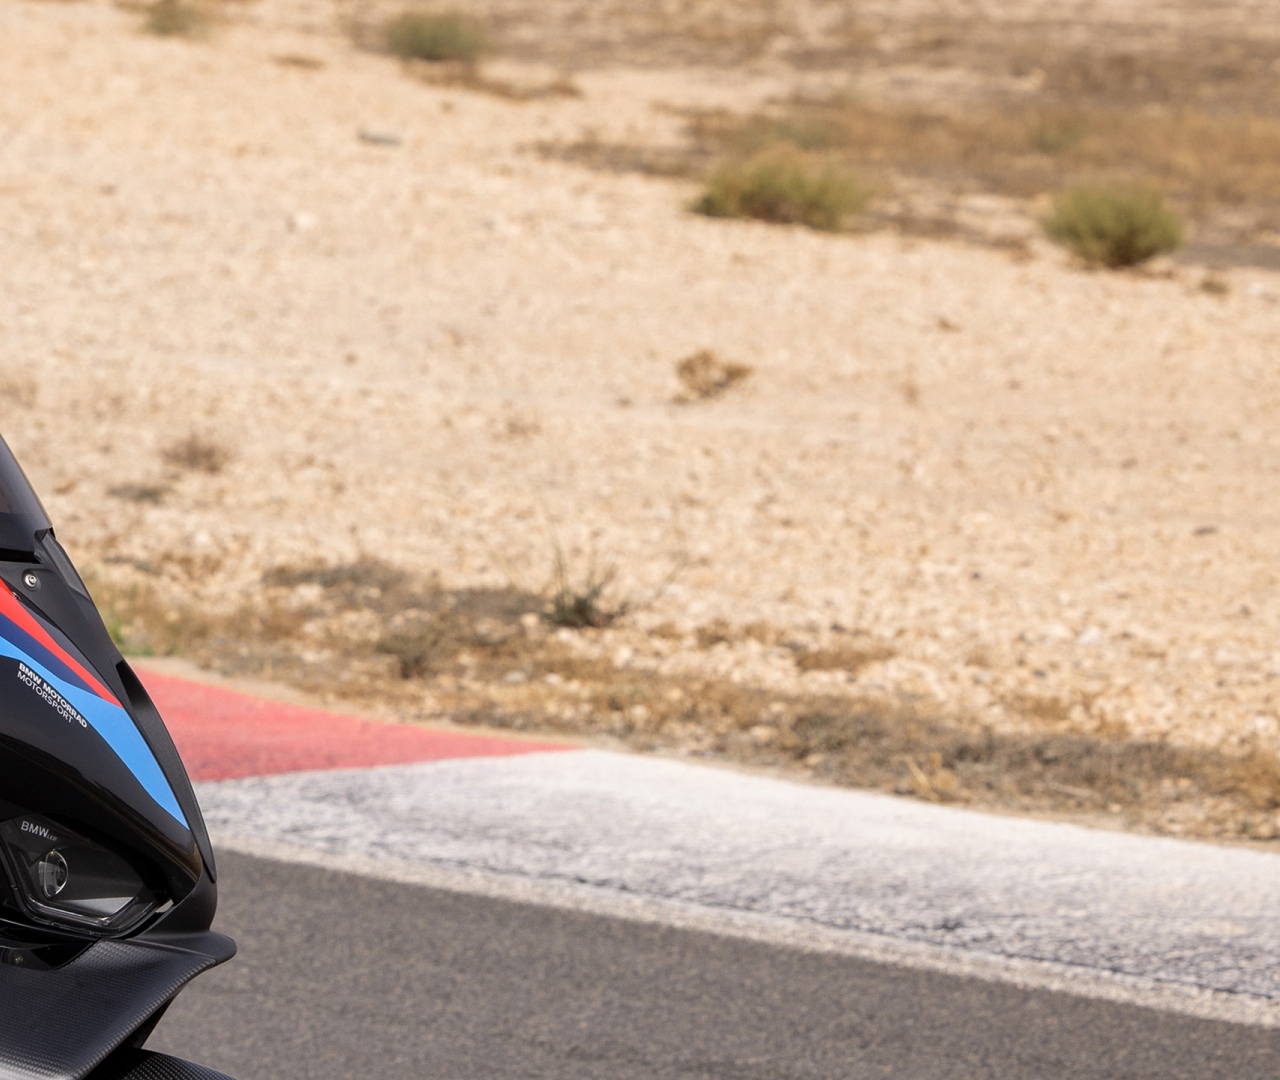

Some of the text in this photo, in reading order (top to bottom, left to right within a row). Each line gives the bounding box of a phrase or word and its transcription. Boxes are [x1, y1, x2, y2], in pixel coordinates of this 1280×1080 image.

[17, 670, 73, 723] MOTORSPORT
[19, 663, 88, 728] BMW MOTORRAD
[20, 820, 49, 838] BMW
